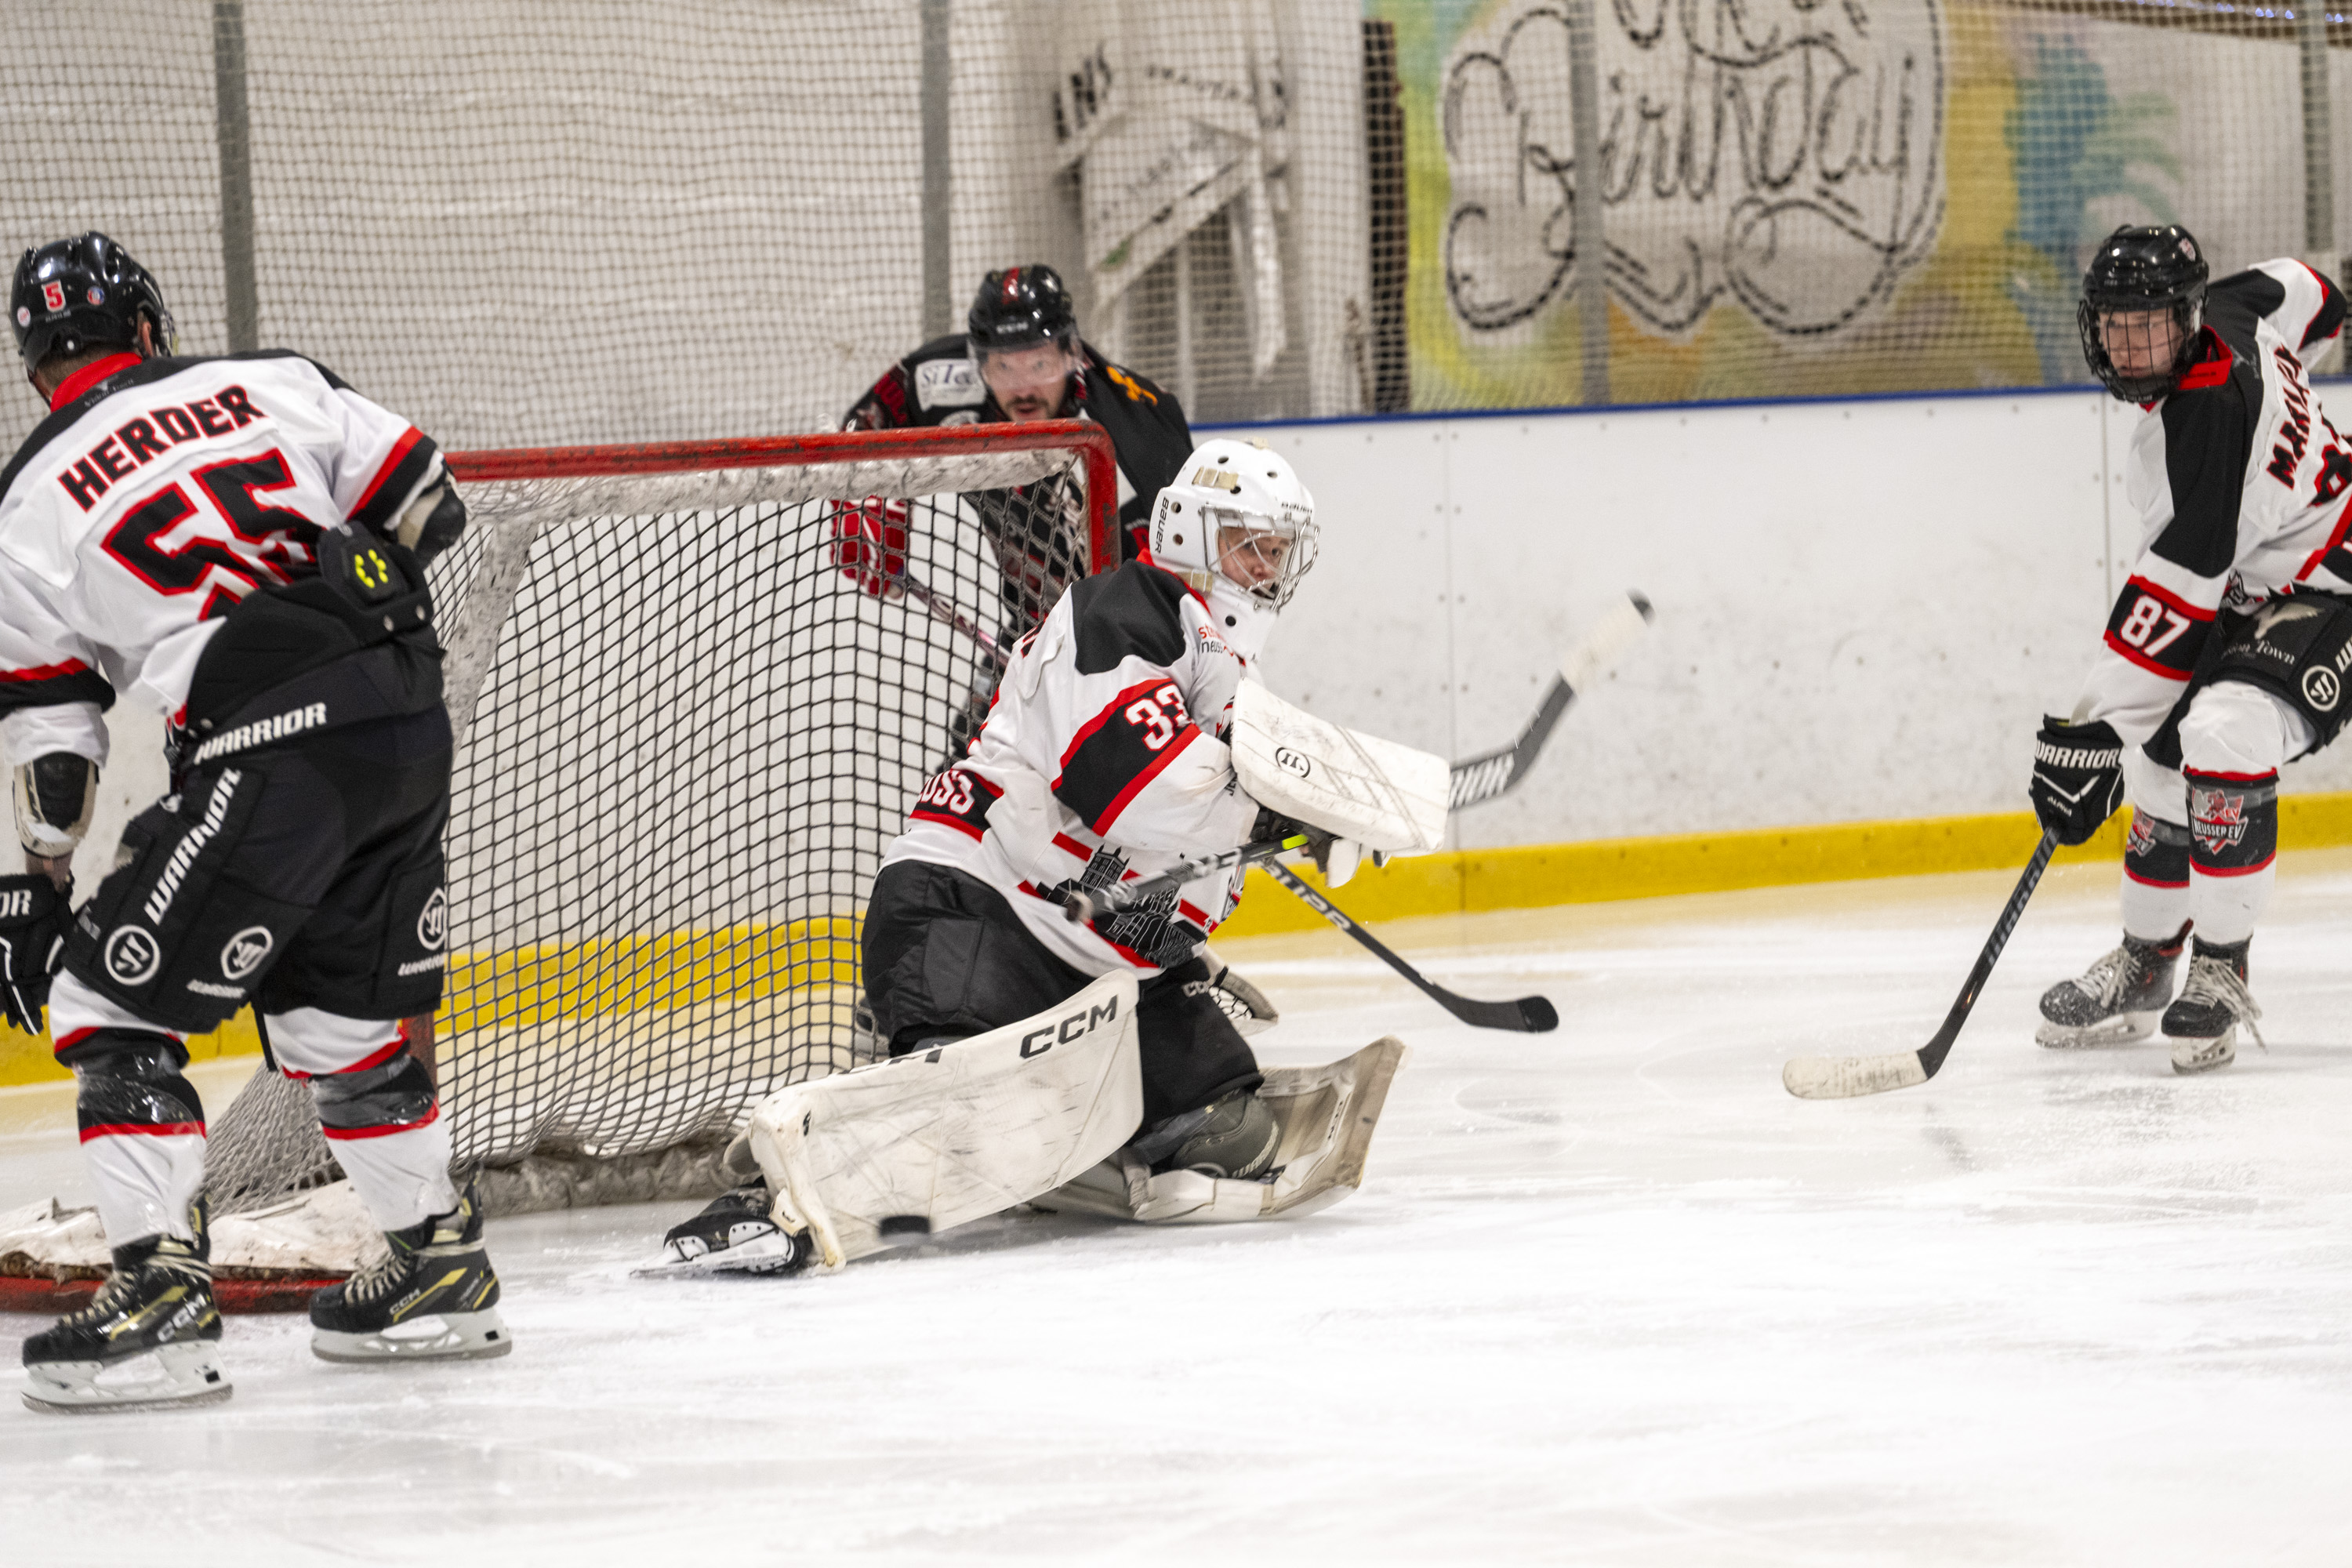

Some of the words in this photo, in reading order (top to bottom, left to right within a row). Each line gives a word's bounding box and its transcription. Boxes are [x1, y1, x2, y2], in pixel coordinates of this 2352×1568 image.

[42, 280, 66, 313] 5
[58, 384, 268, 513] HERDER
[2119, 594, 2193, 657] 87
[1020, 995, 1118, 1059] CCM
